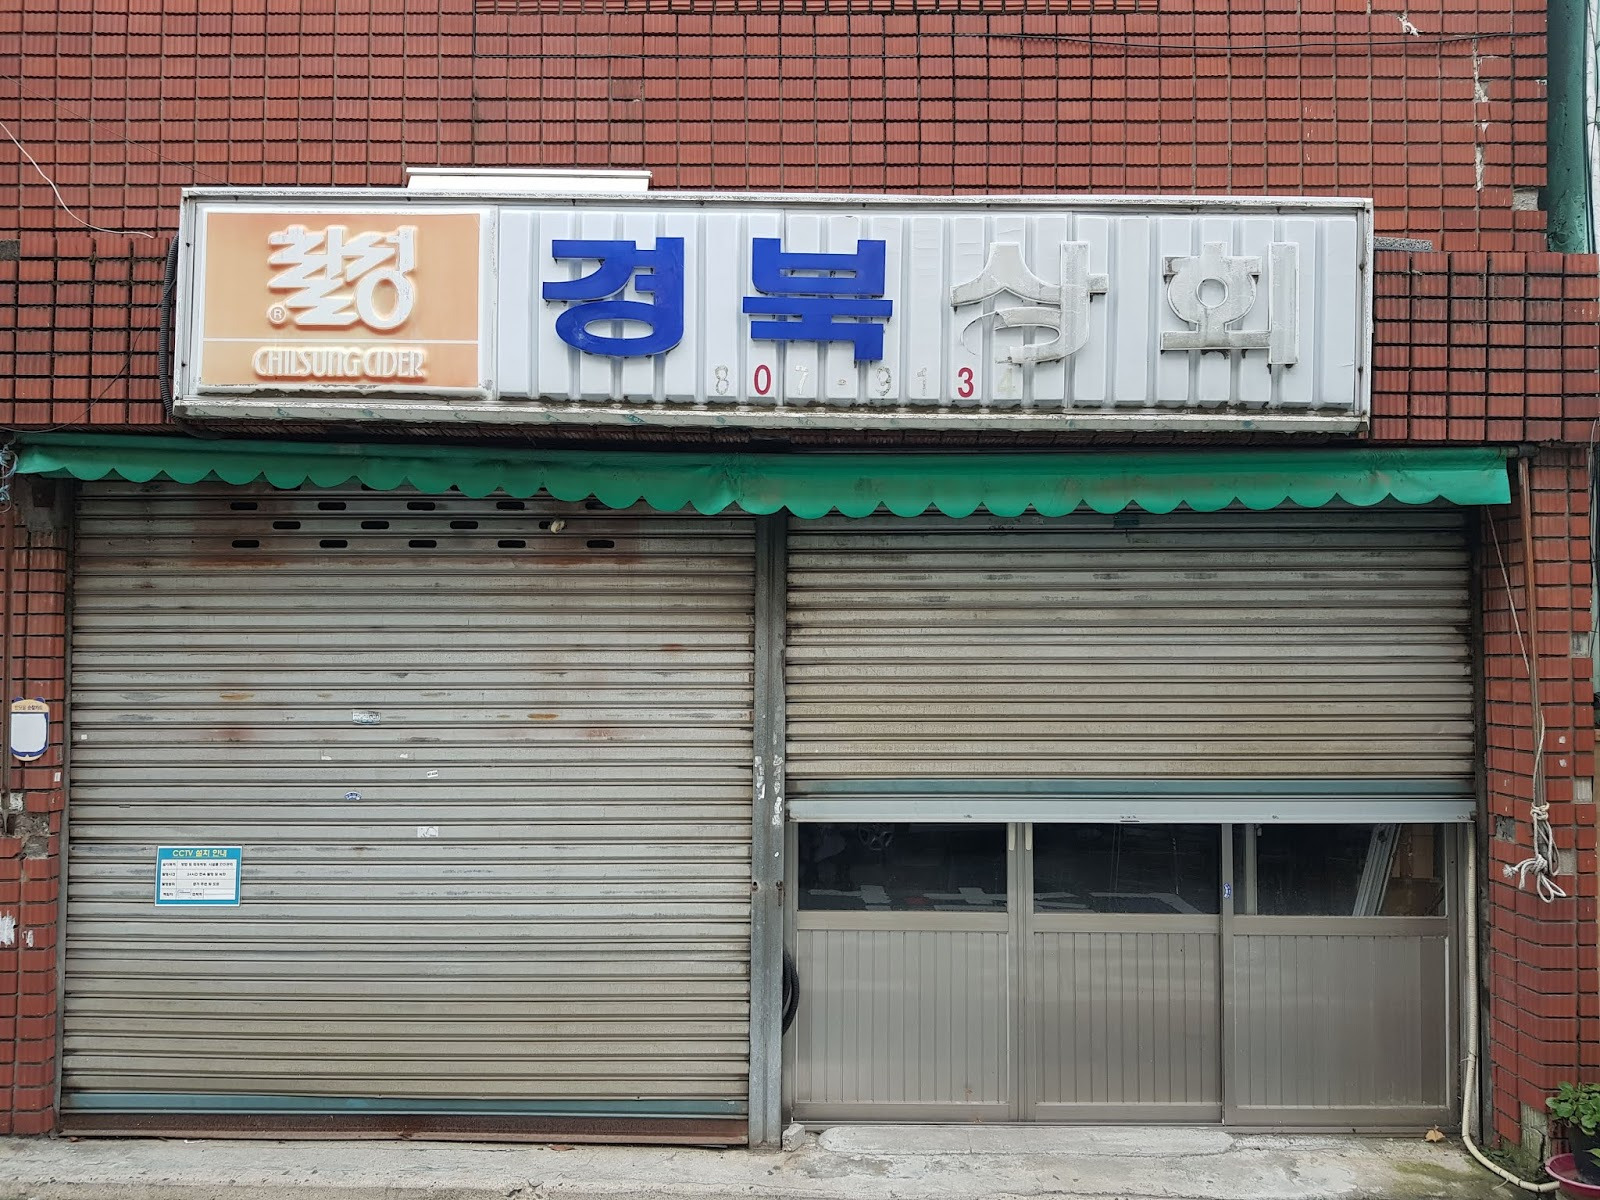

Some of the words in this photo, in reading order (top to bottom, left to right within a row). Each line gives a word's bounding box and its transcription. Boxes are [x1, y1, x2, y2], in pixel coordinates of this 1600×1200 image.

[363, 349, 427, 378] CIDER
[172, 849, 193, 857] CCTV
[212, 849, 227, 857] 안내
